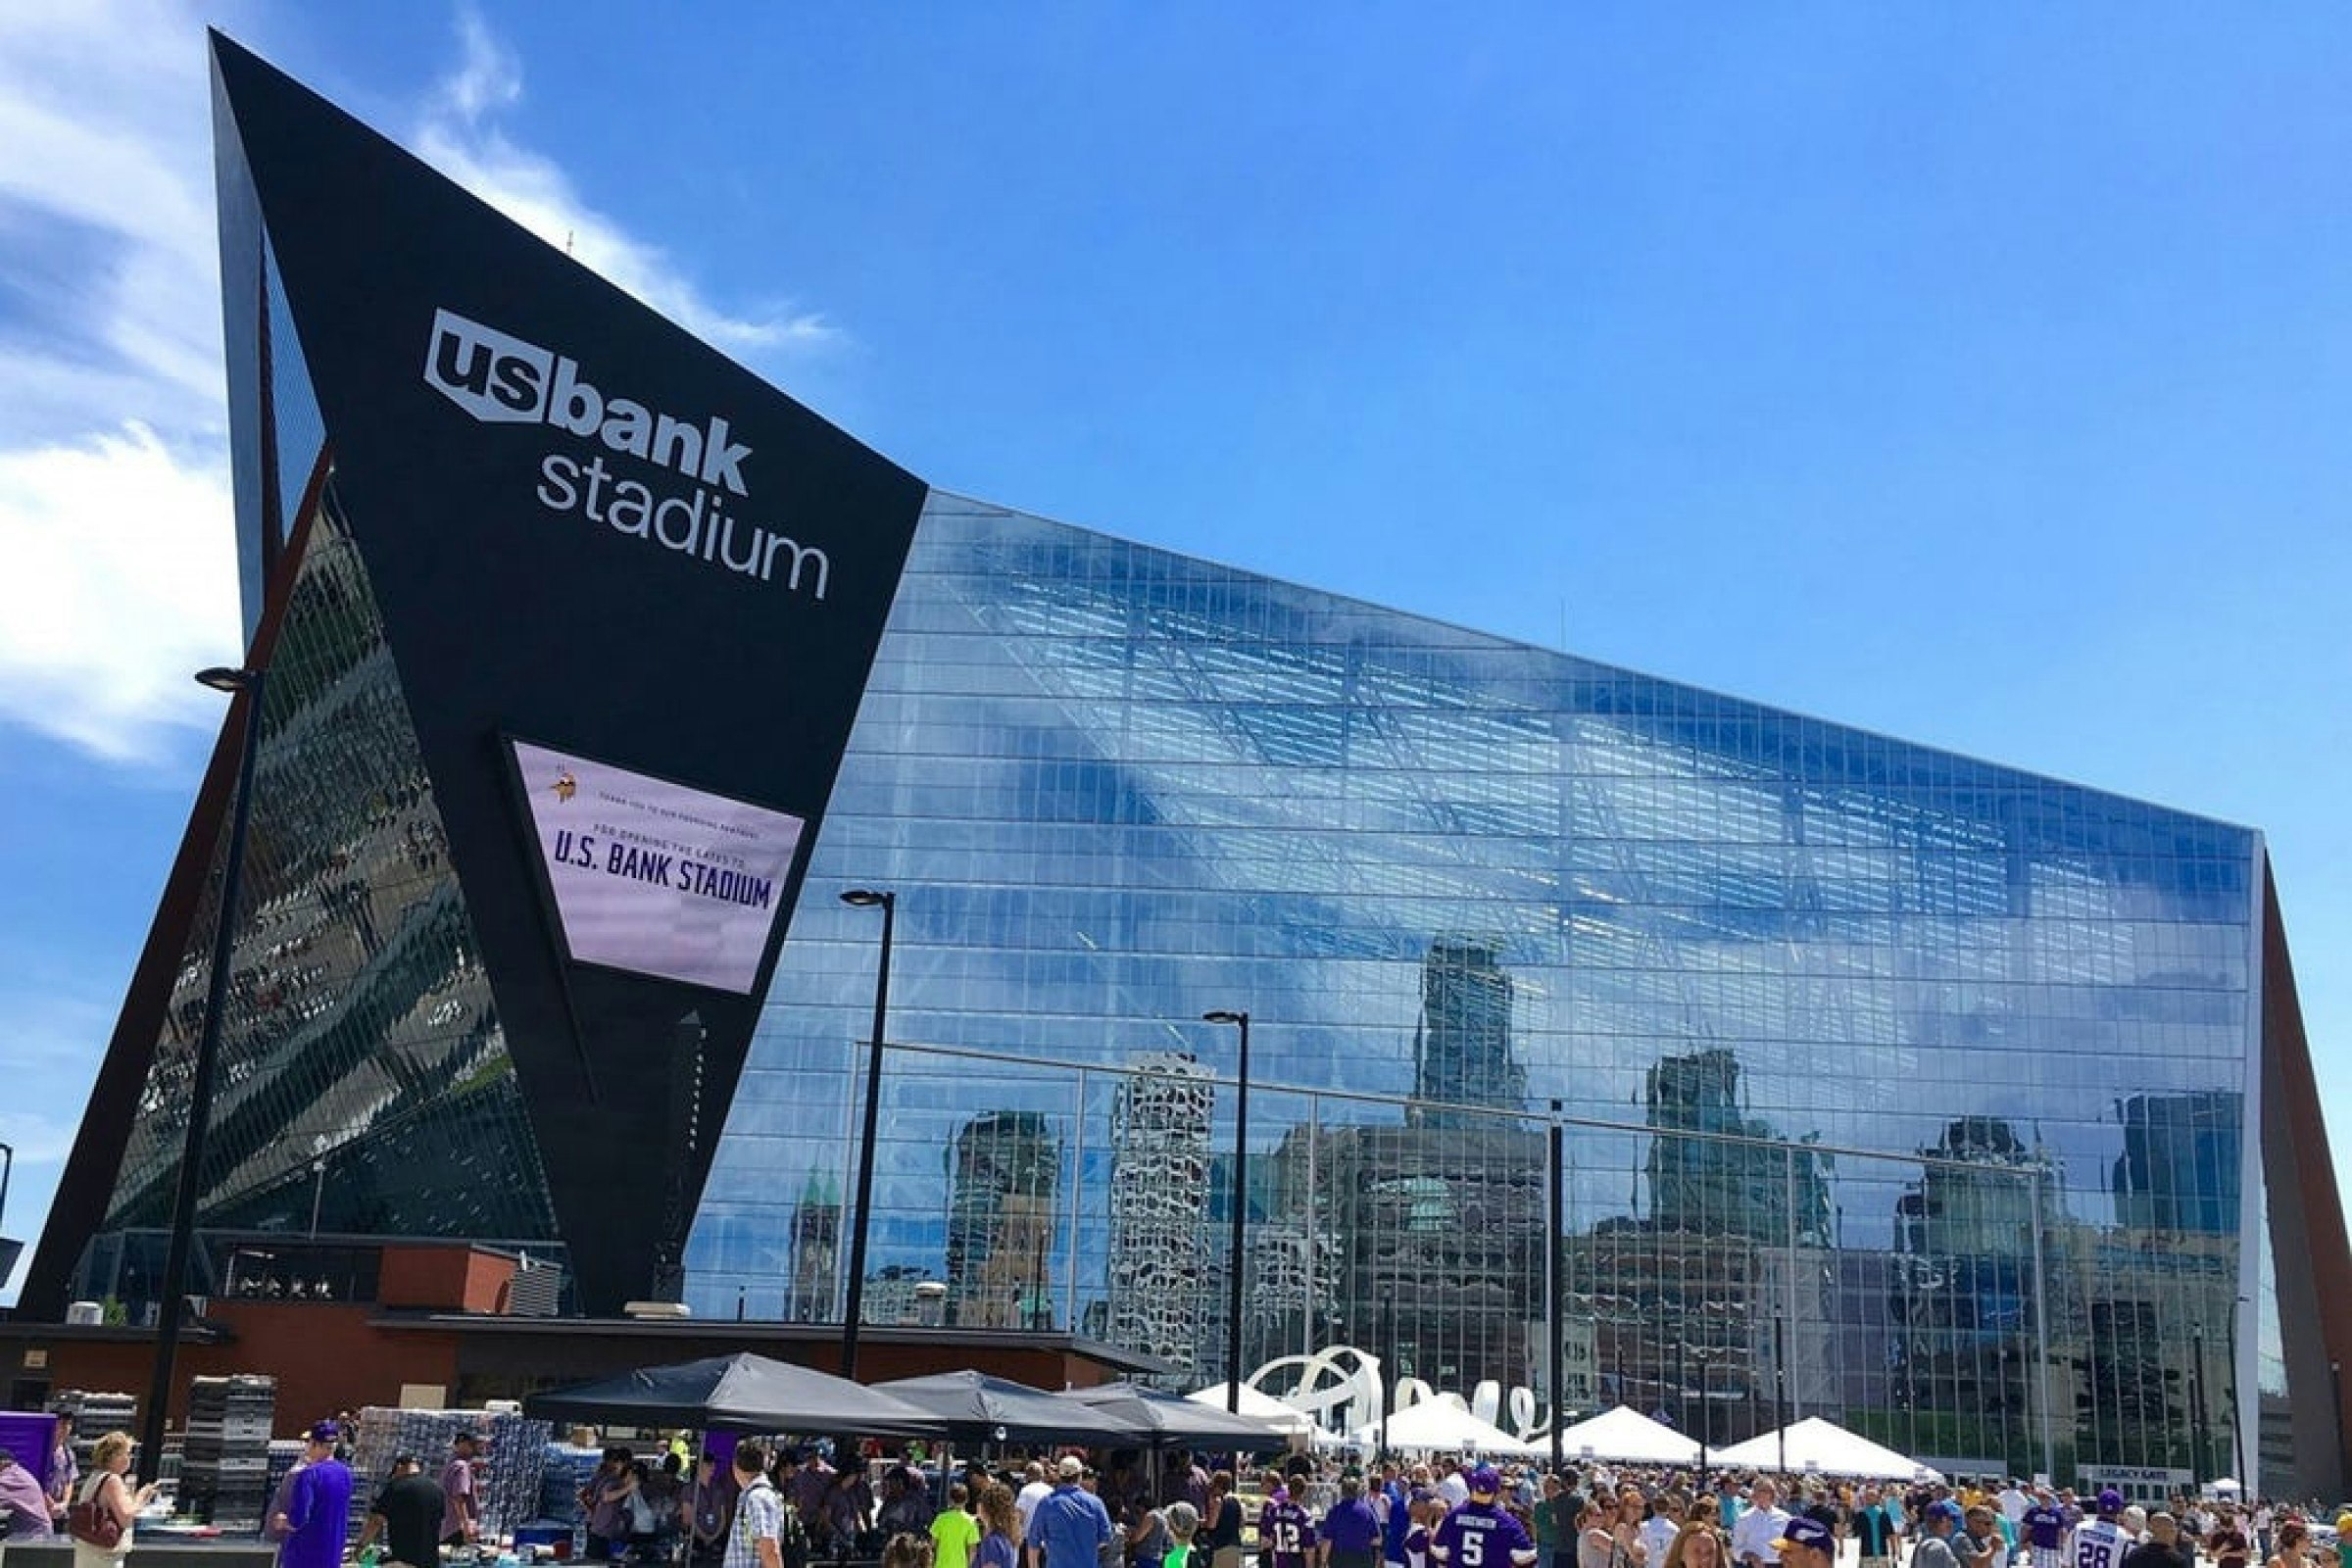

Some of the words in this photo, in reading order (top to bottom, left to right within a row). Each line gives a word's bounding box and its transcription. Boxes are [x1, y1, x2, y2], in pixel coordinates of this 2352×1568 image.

[537, 454, 830, 600] stadium
[555, 829, 598, 870] U.S.
[607, 842, 673, 887] BANK
[677, 859, 771, 910] STADIUM
[1274, 1521, 1300, 1553] 12
[1462, 1531, 1485, 1567] 5
[2078, 1542, 2111, 1568] 28
